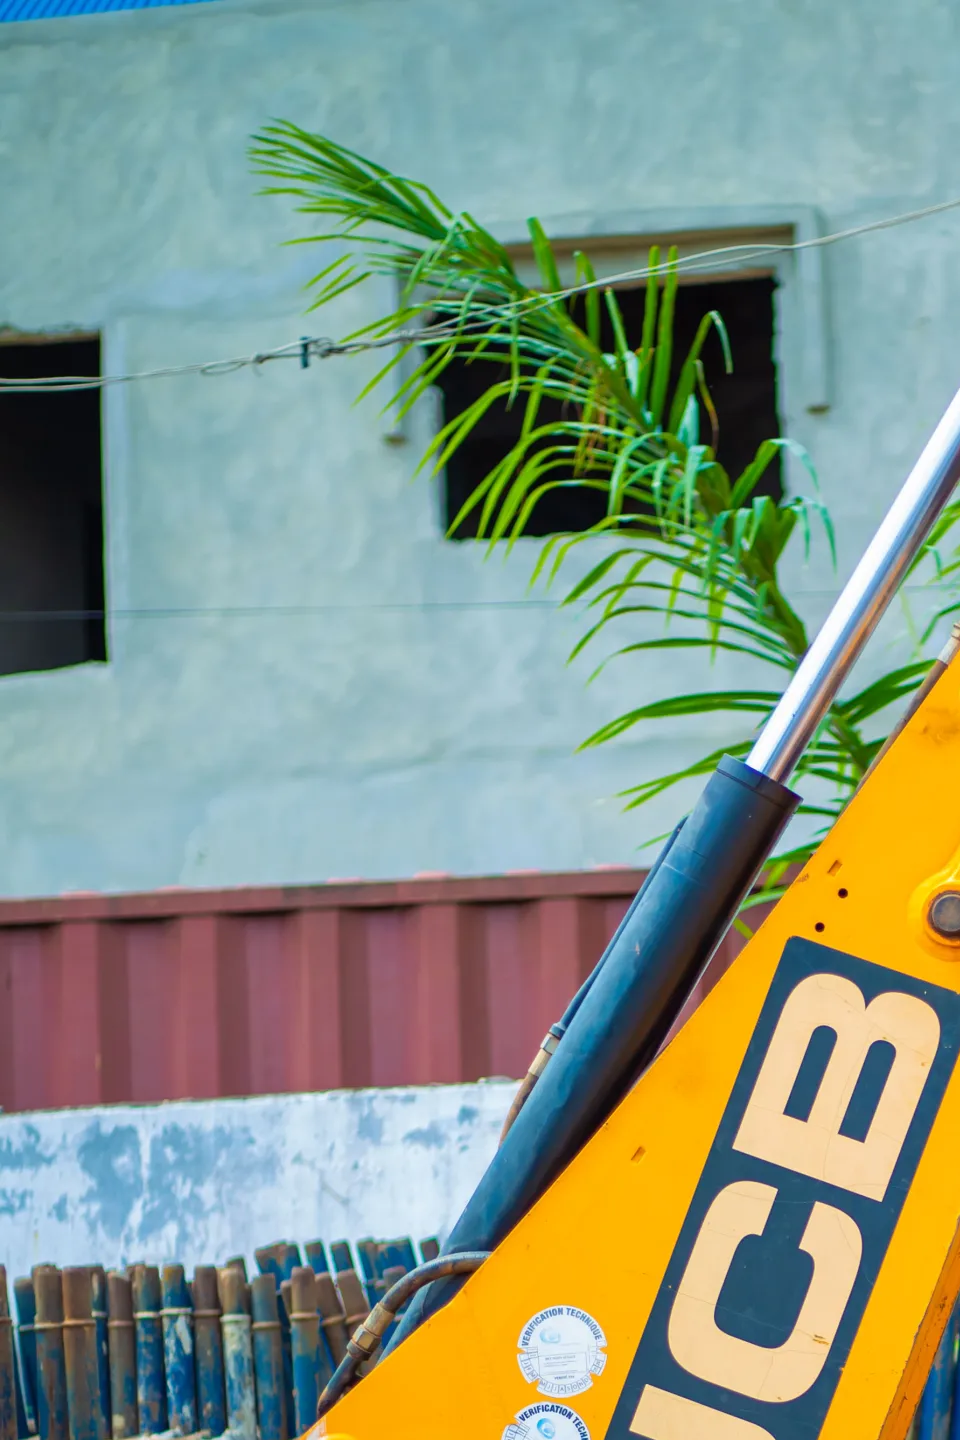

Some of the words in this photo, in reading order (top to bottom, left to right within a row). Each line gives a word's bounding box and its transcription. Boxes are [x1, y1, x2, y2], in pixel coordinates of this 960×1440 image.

[521, 1307, 564, 1347] VERIFICATION
[566, 1307, 603, 1341] TECHNIQUE
[518, 1404, 574, 1422] VERIFICATION
